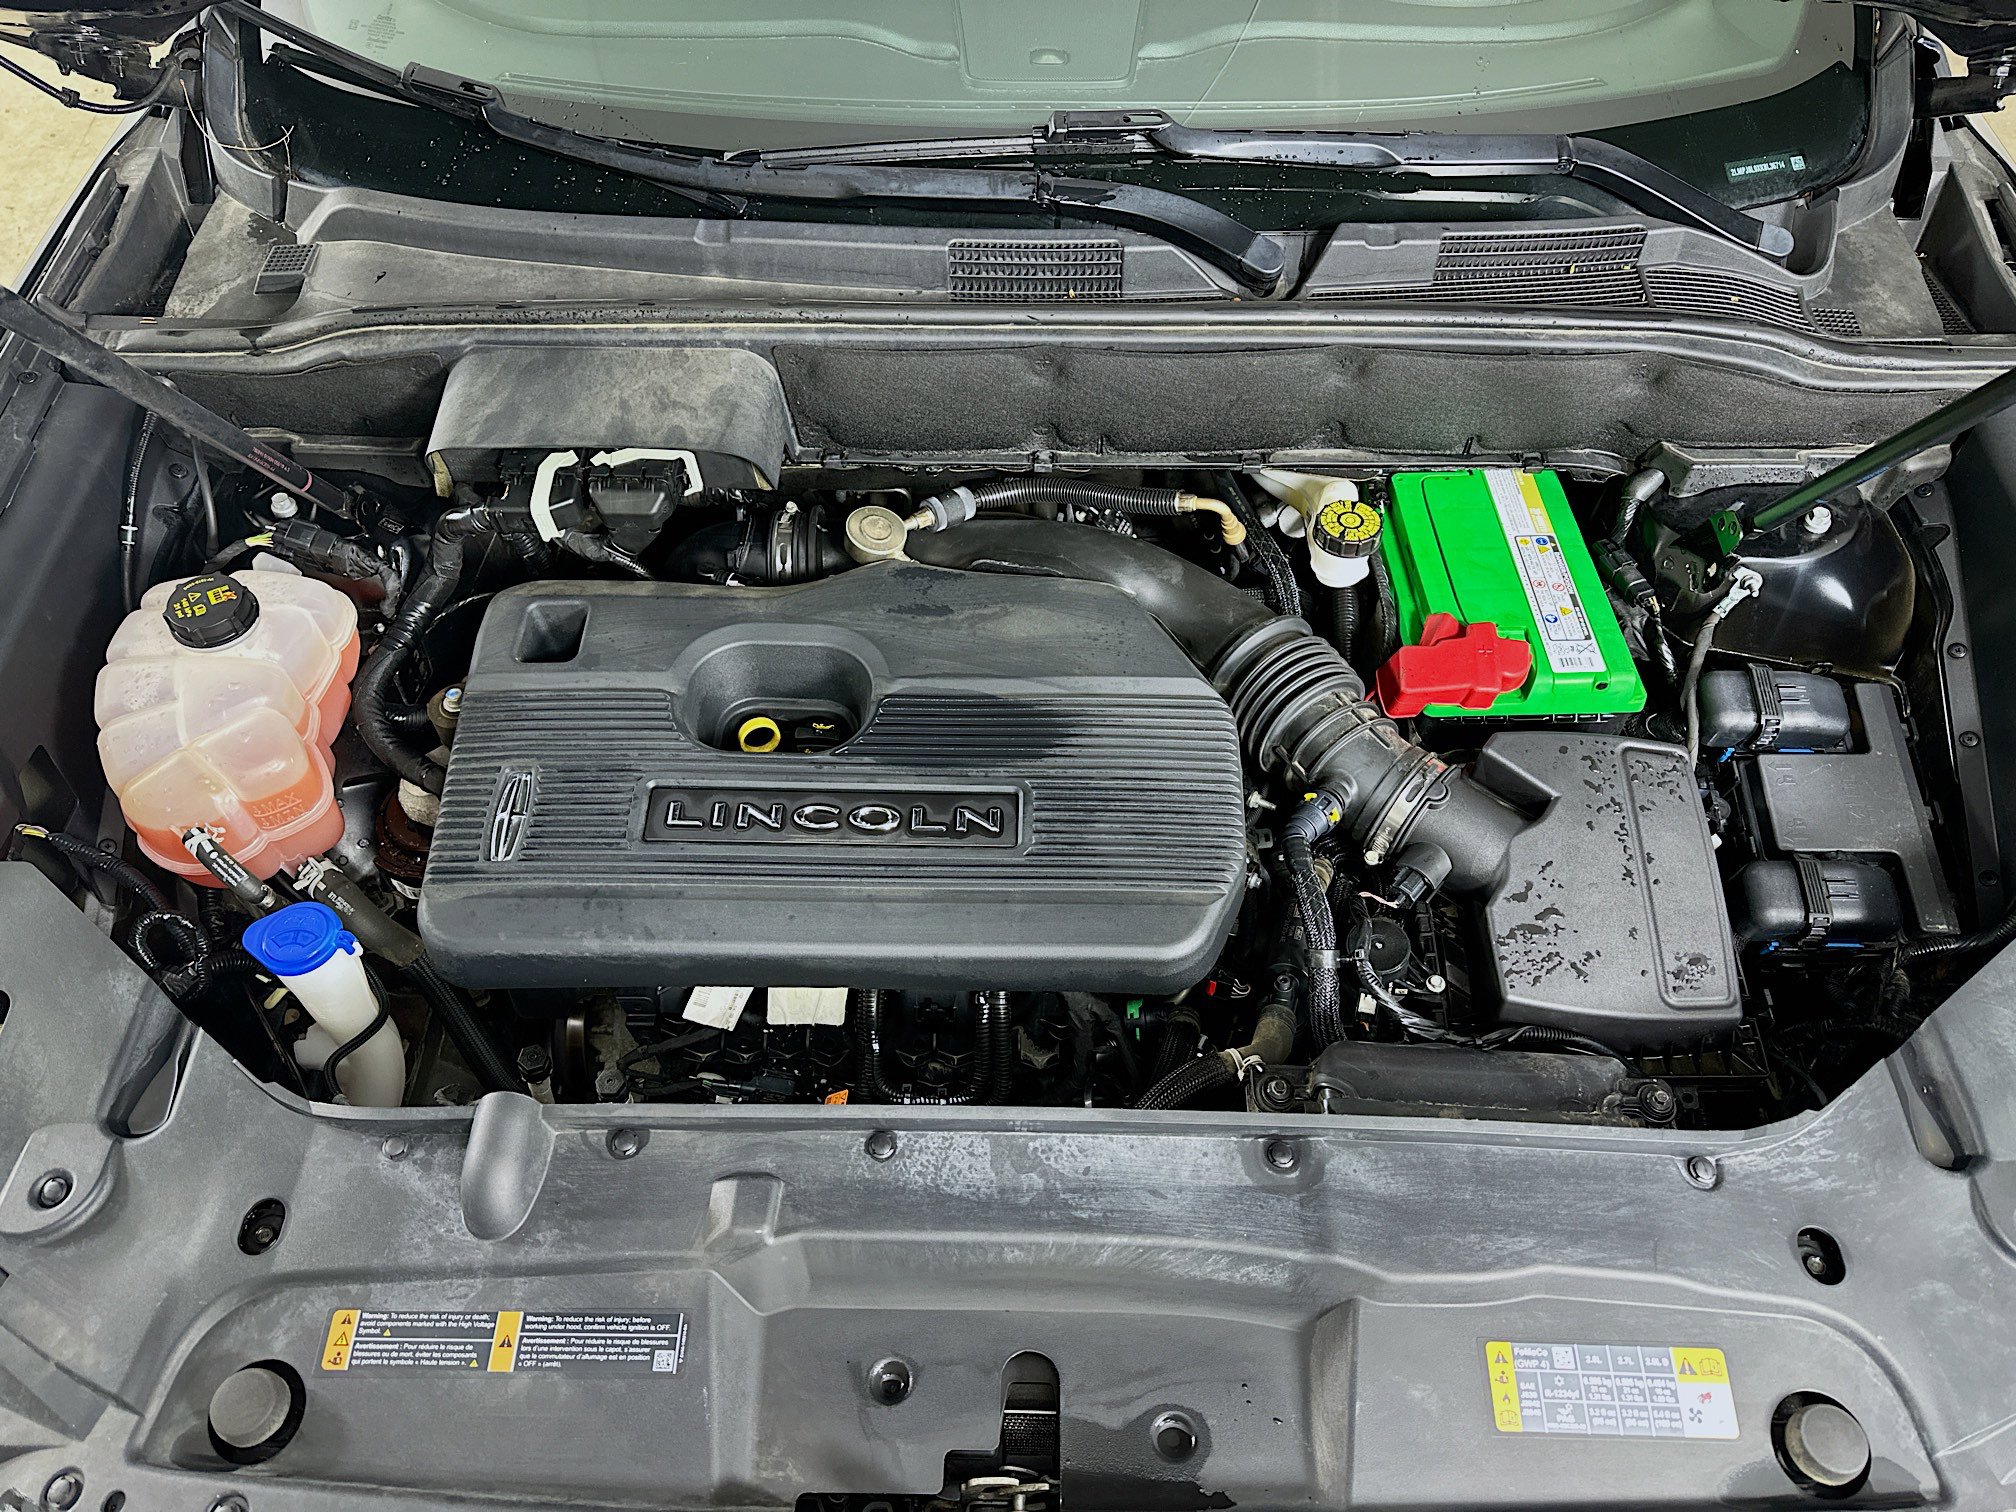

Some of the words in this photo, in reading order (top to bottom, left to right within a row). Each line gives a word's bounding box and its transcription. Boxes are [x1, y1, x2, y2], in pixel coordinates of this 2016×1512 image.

[666, 801, 1000, 833] LINCOLN
[362, 1312, 389, 1320] Warning:
[1514, 1347, 1548, 1356] FoMoCo
[1514, 1359, 1539, 1369] (GWP
[1540, 1360, 1550, 1370] 4)
[1617, 1356, 1634, 1365] 2.7L
[1520, 1382, 1535, 1390] SAE
[1602, 1377, 1612, 1388] kg
[1634, 1379, 1644, 1389] kg
[1666, 1380, 1676, 1390] kg
[1544, 1389, 1580, 1399] R-1234yf
[1556, 1414, 1575, 1423] PAG
